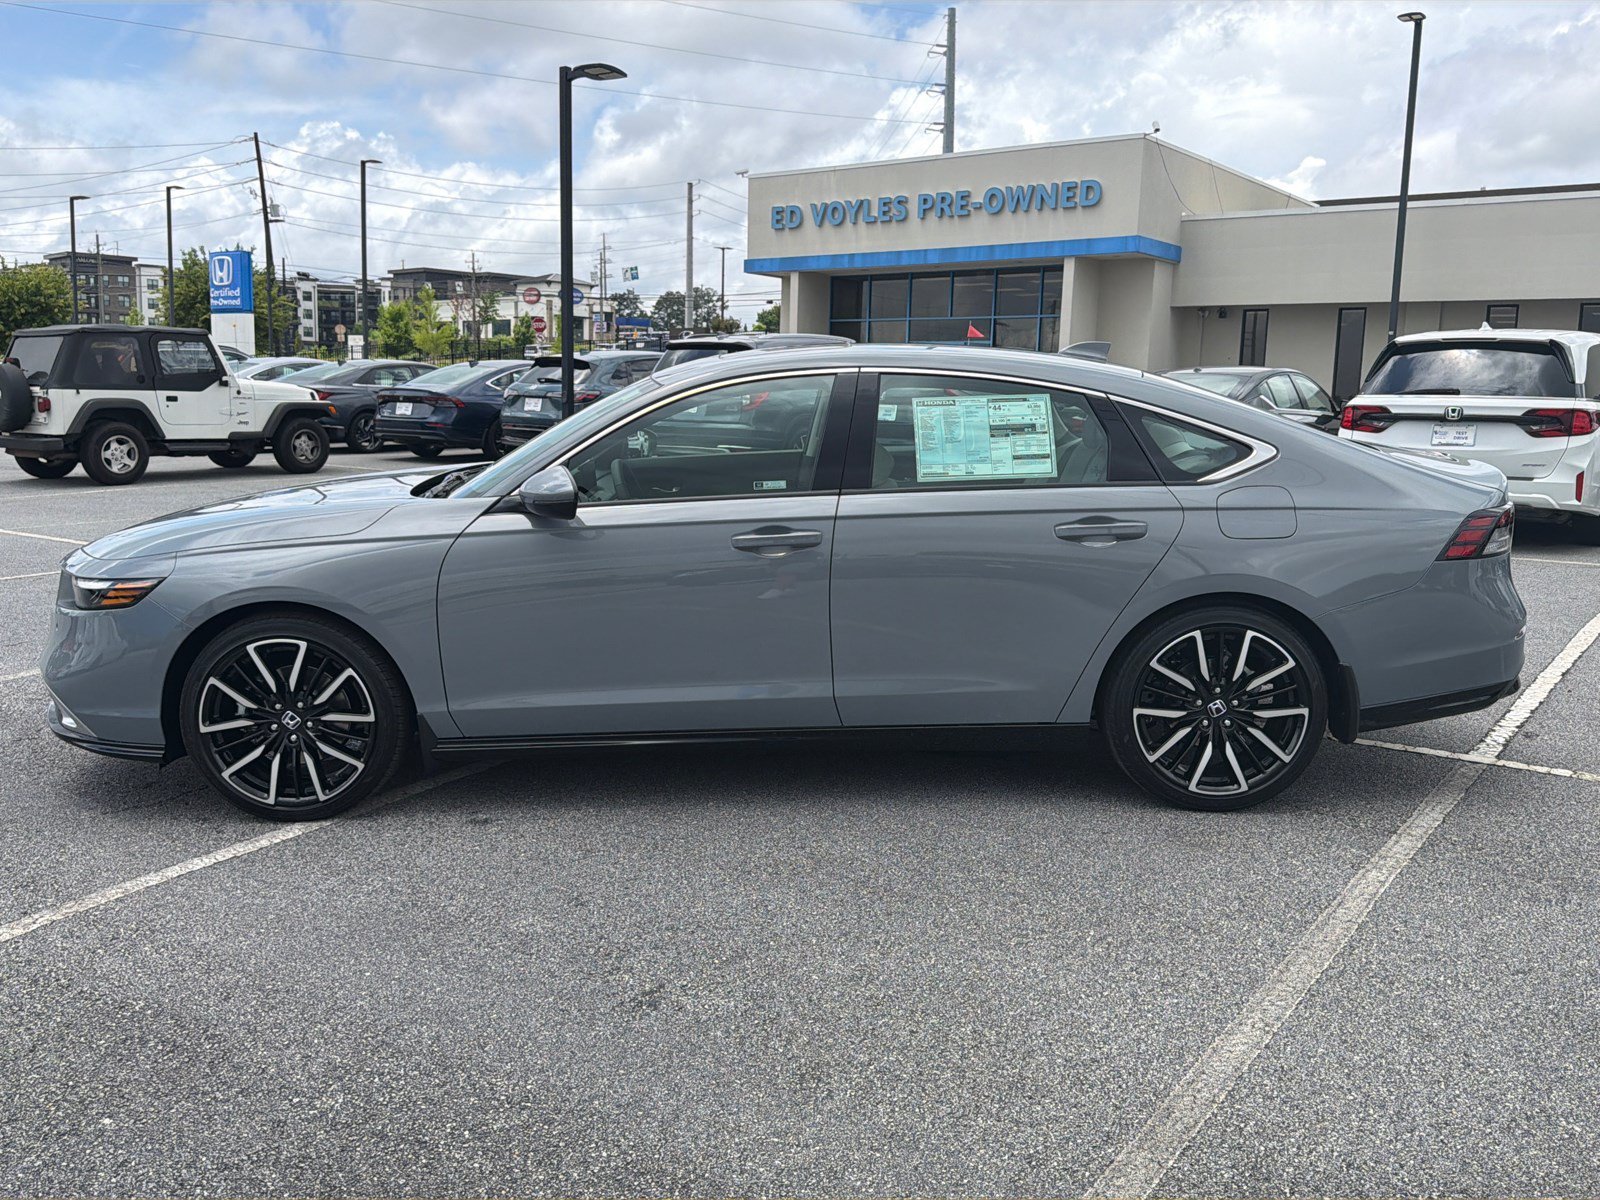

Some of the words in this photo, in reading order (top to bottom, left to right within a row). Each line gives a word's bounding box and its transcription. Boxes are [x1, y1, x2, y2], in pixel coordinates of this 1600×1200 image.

[771, 204, 803, 230] ED
[810, 195, 909, 227] VOYLES
[917, 179, 1103, 219] PRE-OWNED
[210, 287, 240, 297] Certified
[210, 297, 240, 306] Pre-Owned
